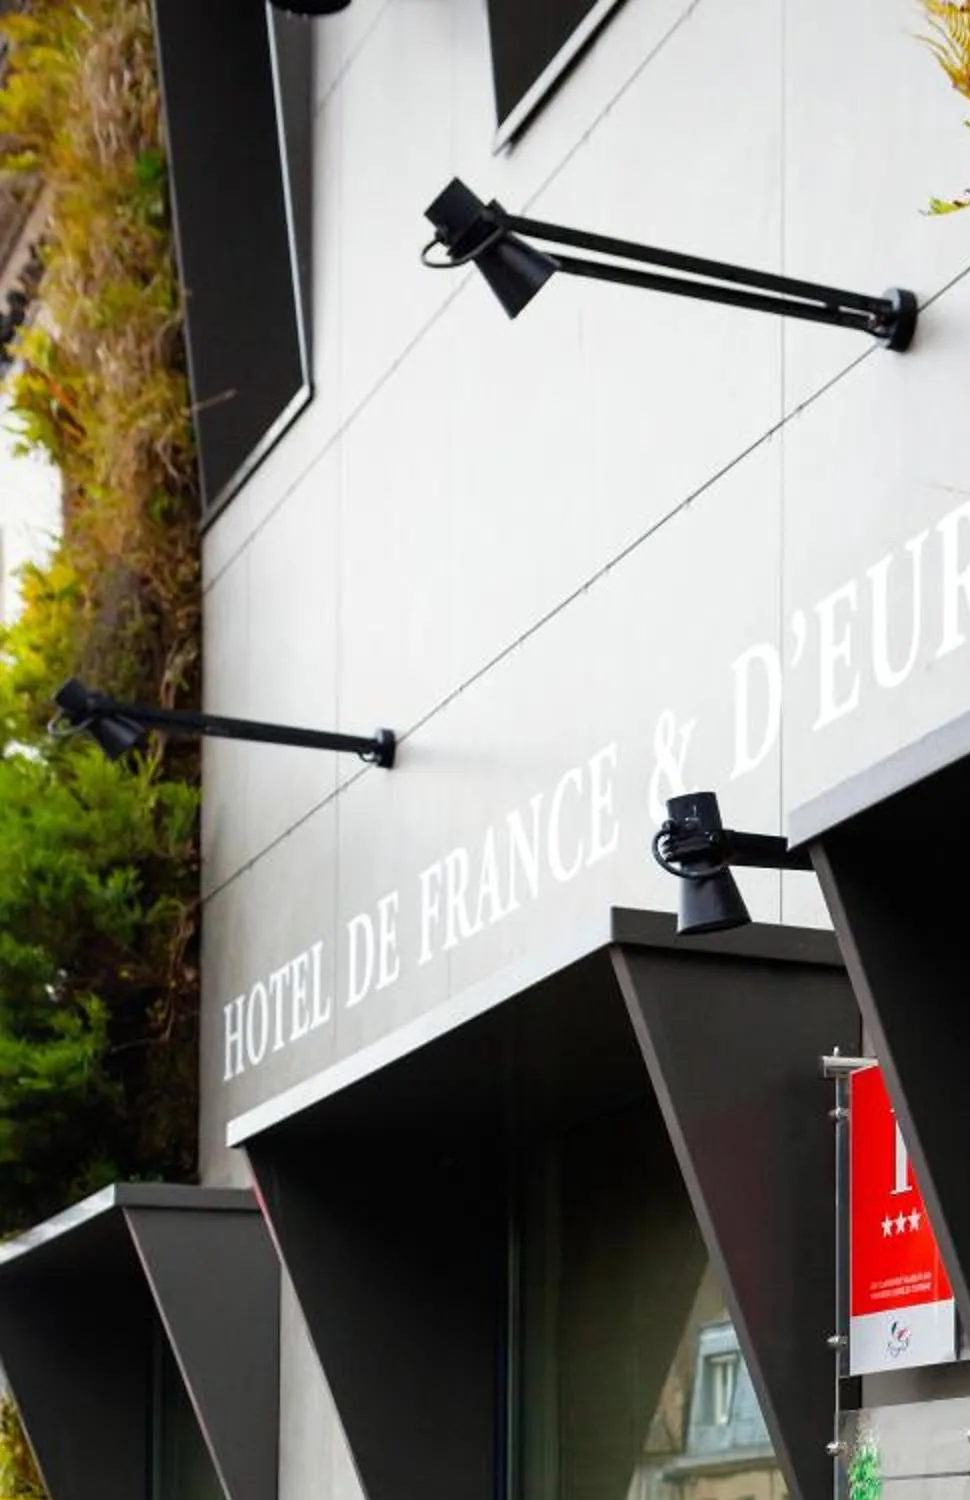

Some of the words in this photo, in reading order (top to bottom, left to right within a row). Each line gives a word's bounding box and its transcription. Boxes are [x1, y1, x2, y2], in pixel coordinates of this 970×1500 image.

[223, 940, 330, 1082] HOTEL
[345, 890, 399, 1008] DE
[418, 743, 619, 966] FRANCE
[650, 708, 696, 826] &
